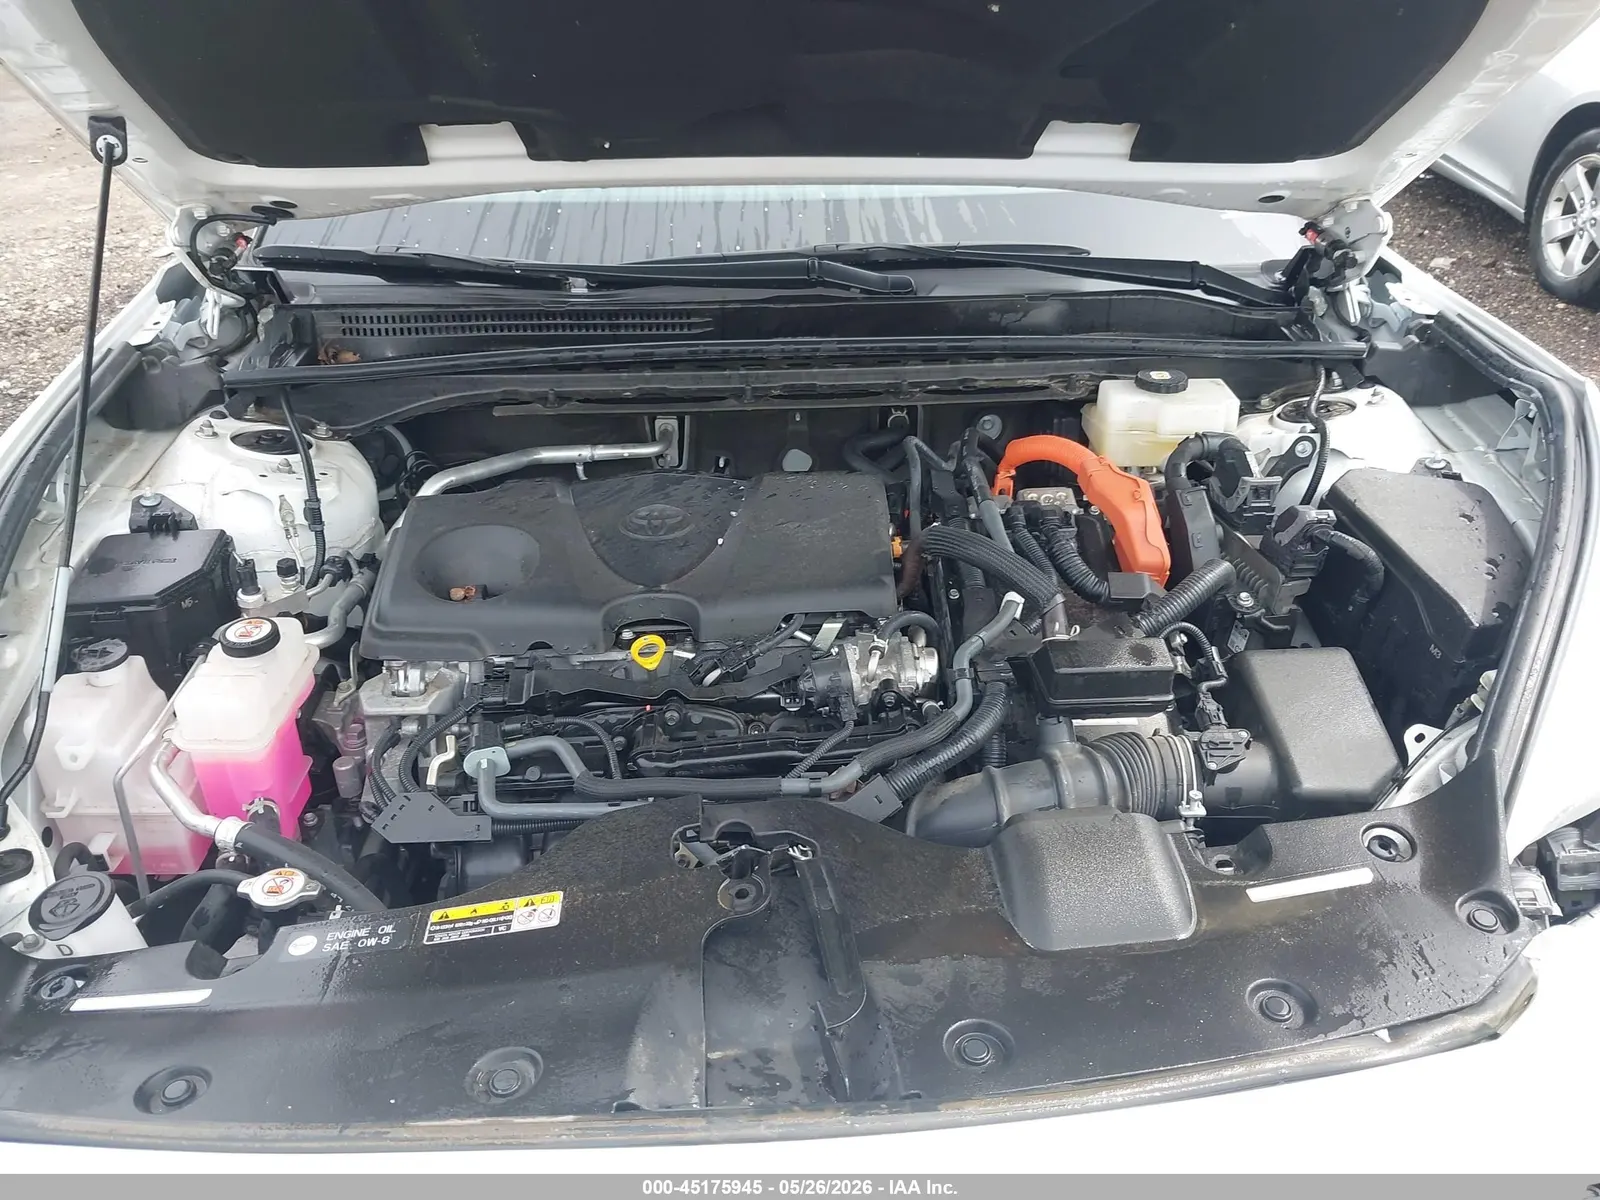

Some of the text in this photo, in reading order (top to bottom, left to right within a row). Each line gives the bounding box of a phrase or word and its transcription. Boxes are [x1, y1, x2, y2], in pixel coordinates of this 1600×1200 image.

[326, 924, 397, 941] ENGINE OIL
[322, 940, 351, 952] SAE
